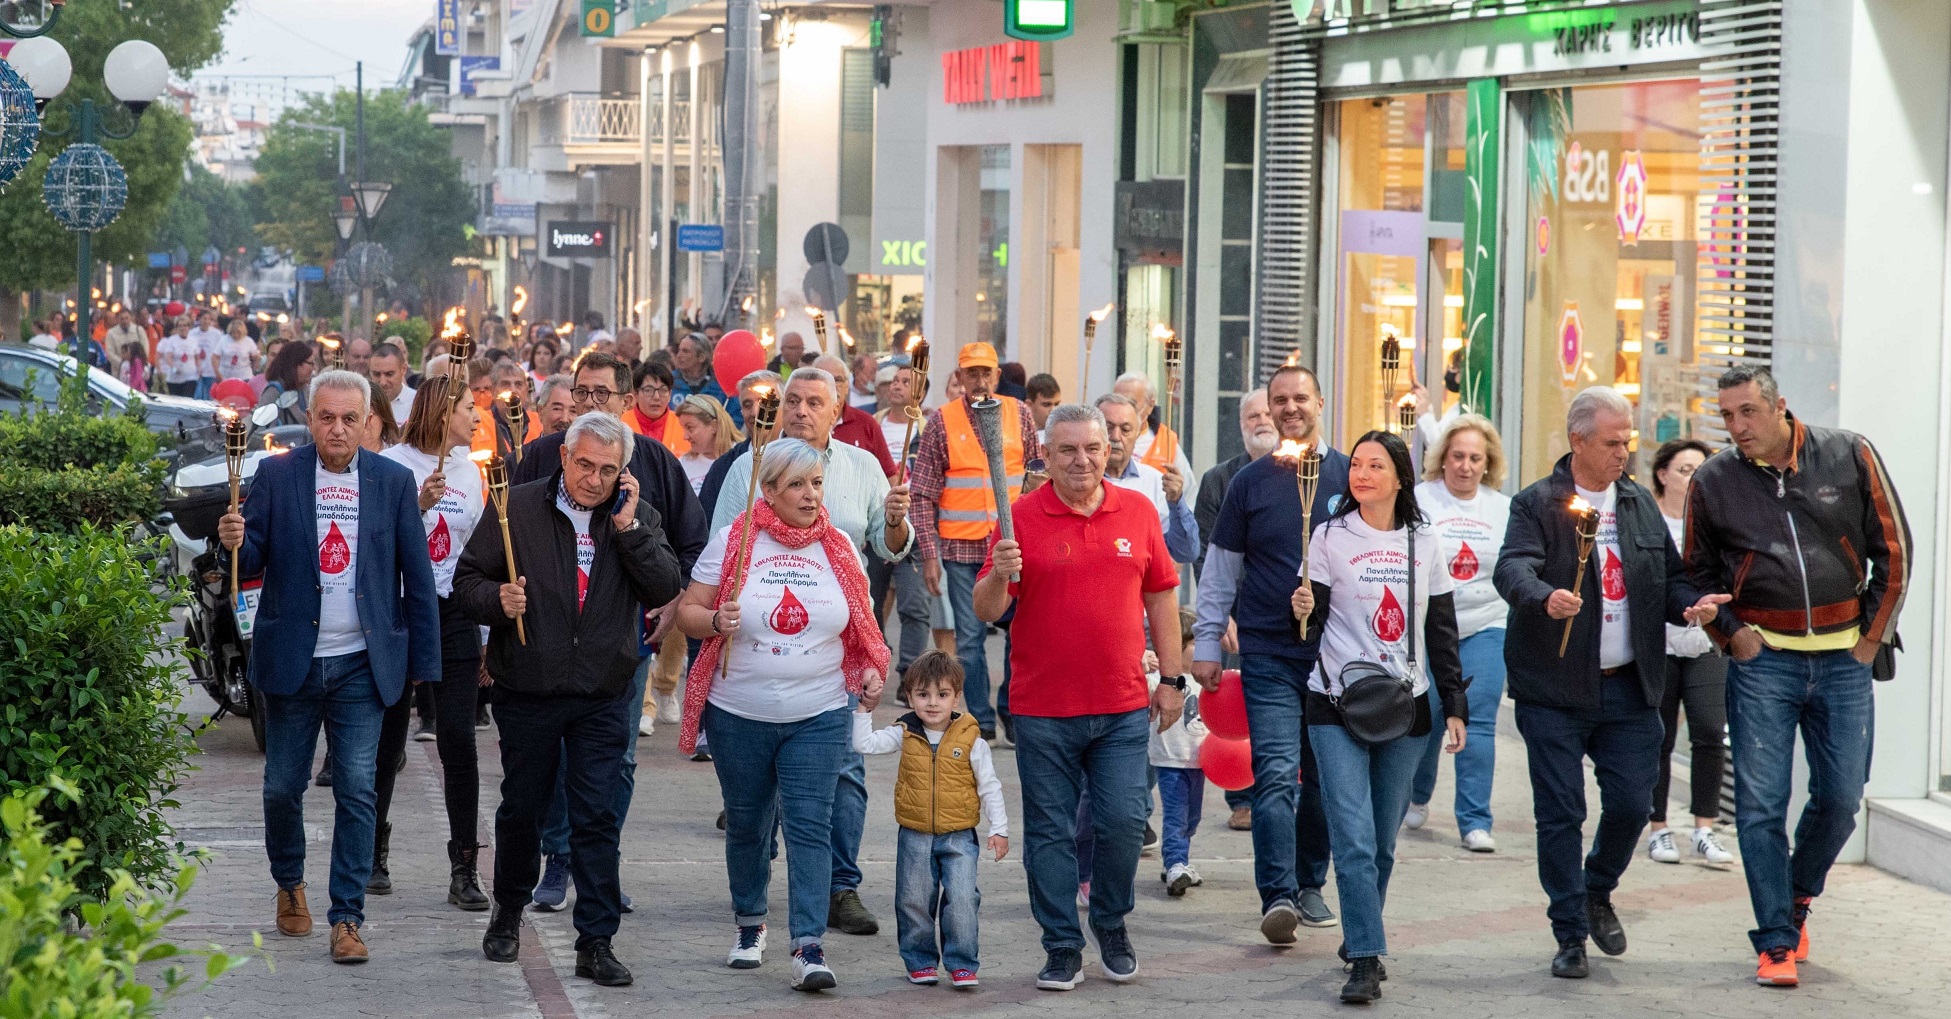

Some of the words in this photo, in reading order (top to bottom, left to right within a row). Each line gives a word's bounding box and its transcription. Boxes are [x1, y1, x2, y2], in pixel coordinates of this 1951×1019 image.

[1630, 11, 1701, 50] ΒΕΡΙΤΟ
[942, 46, 986, 104] TALLY
[552, 229, 593, 249] lynne
[322, 494, 354, 502] ΕΛΛΑΔΑΣ
[316, 504, 358, 512] Πανελλήνια
[316, 512, 359, 522] μπαδηδρομ
[754, 555, 789, 568] ΕΘΕΛΟΝΤΕΣ
[790, 555, 825, 571] ΑΙΜΟΔΟΤΕΣ
[1349, 551, 1384, 566] ΕΘΕΛΟΝΤΕΣ
[1386, 551, 1422, 568] ΑΙΜΟΔΕΣ
[1358, 575, 1411, 585] Λαμπαδηδρομ
